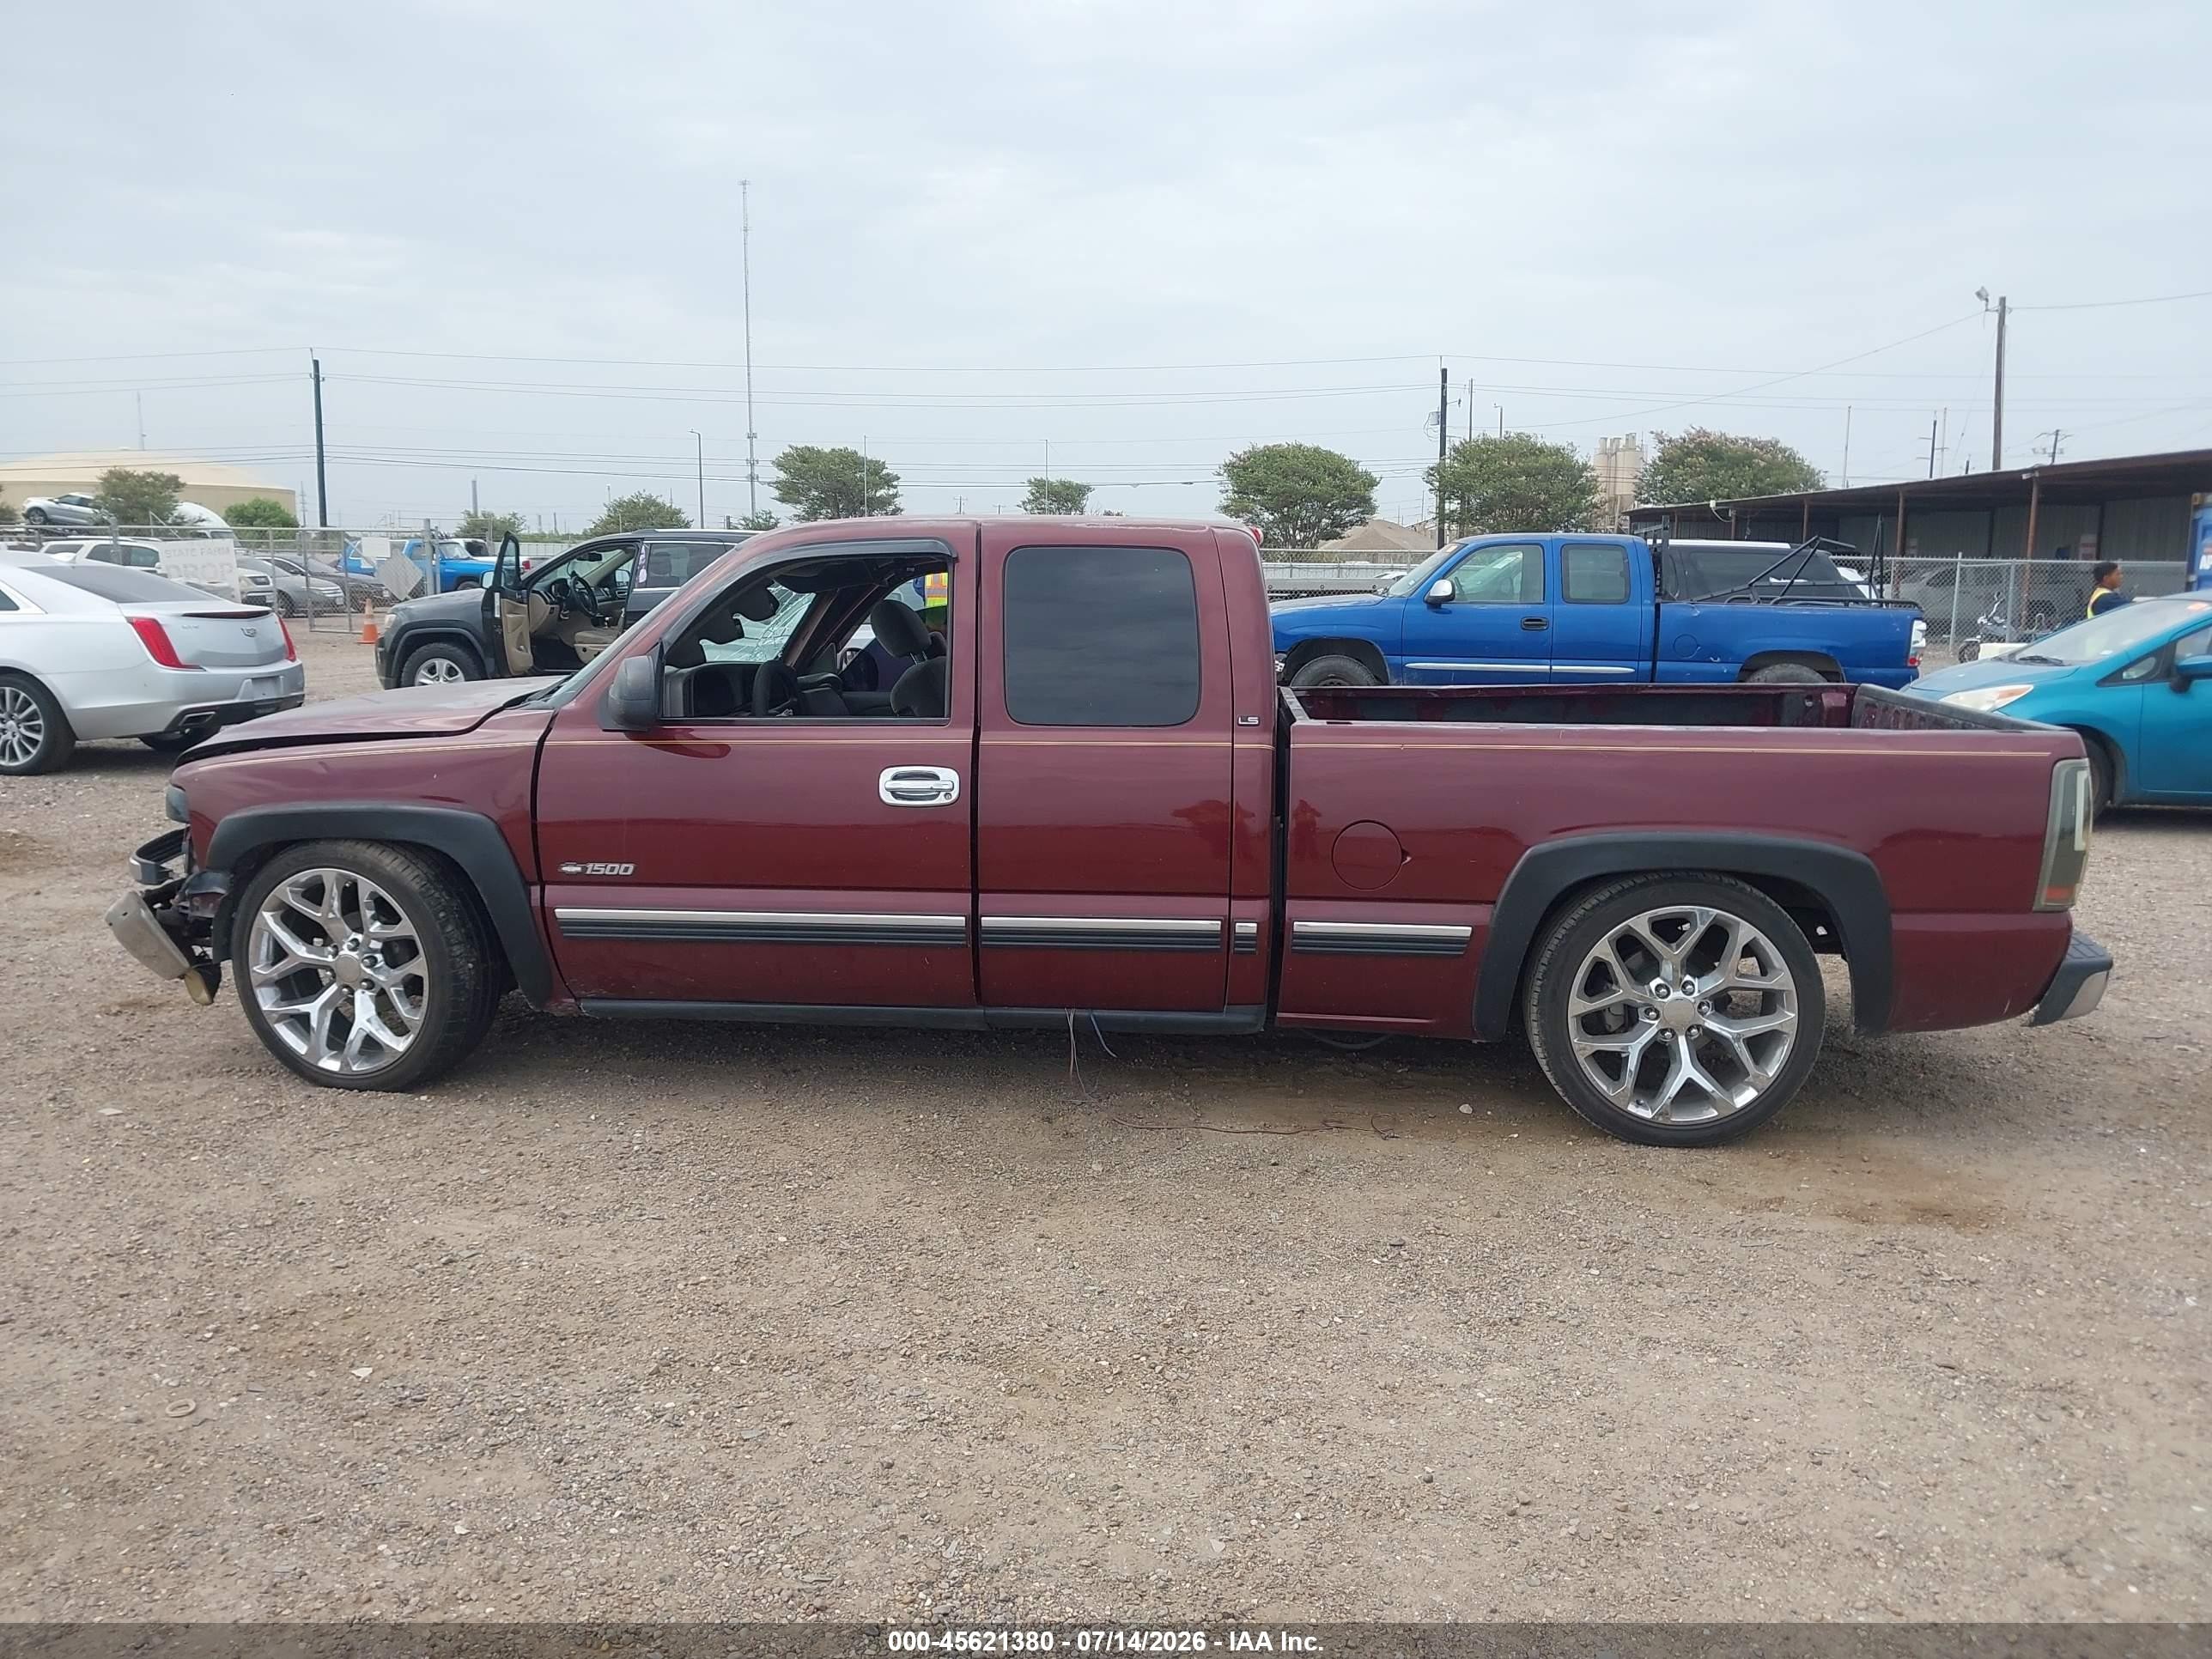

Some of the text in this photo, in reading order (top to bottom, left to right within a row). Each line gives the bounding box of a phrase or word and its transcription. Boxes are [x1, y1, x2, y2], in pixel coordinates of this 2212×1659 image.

[164, 548, 198, 558] STATE
[1237, 715, 1260, 726] LS
[585, 862, 636, 876] 1500
